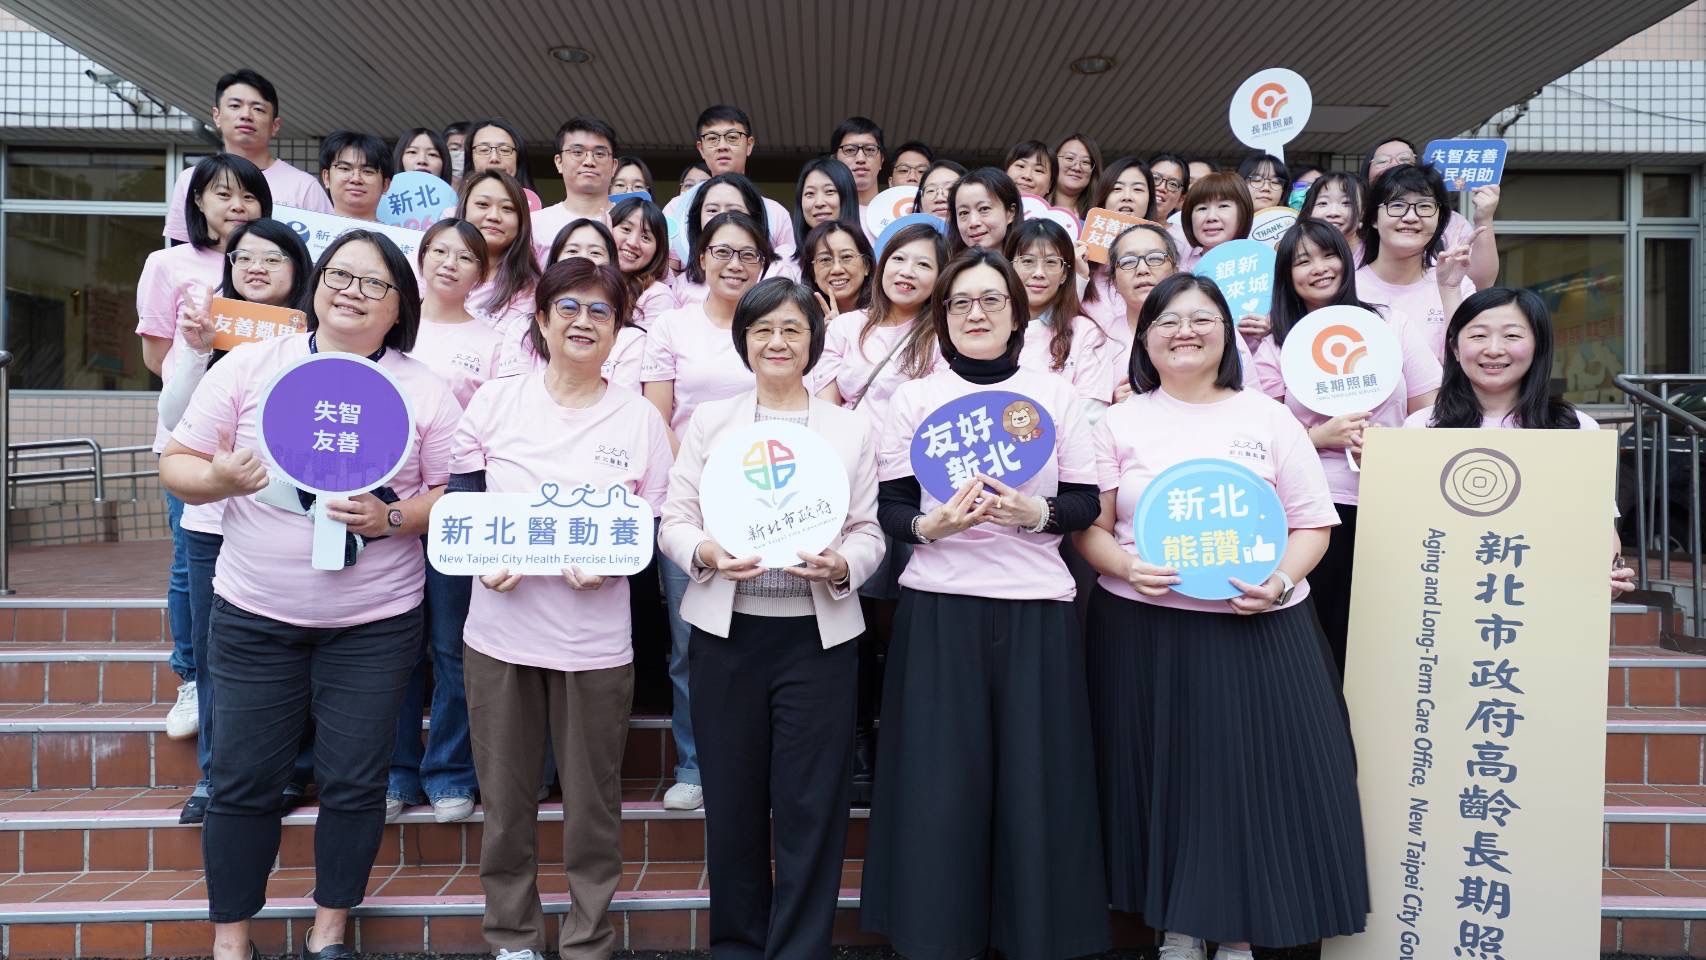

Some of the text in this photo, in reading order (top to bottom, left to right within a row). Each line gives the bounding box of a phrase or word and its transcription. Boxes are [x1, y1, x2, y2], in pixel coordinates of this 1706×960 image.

[1250, 116, 1294, 135] 長期照顧
[1430, 148, 1500, 164] 失智友善
[1441, 167, 1495, 183] 民相助
[387, 184, 441, 216] 新北
[1256, 222, 1284, 238] THANK
[1315, 373, 1378, 395] 長期照顧
[313, 400, 361, 425] 失智
[312, 429, 360, 454] 友善
[920, 405, 994, 458] 友好
[945, 440, 1022, 490] 新北
[748, 498, 832, 541] 新北市政府
[1167, 483, 1249, 522] 新北
[440, 515, 640, 546] 新北醫動養
[439, 553, 640, 567] New Taipei City Health Exercise Living
[1161, 529, 1241, 568] 熊讚
[1420, 527, 1446, 573] Aging
[1423, 576, 1443, 607] and
[1415, 609, 1441, 694] Long-Term
[1414, 698, 1436, 734] Care
[1408, 737, 1434, 788] Office,
[1453, 530, 1531, 960] 新北市政府高齡長期照
[1408, 797, 1430, 836] New
[1400, 840, 1427, 891] Taipei
[1396, 893, 1424, 928] City
